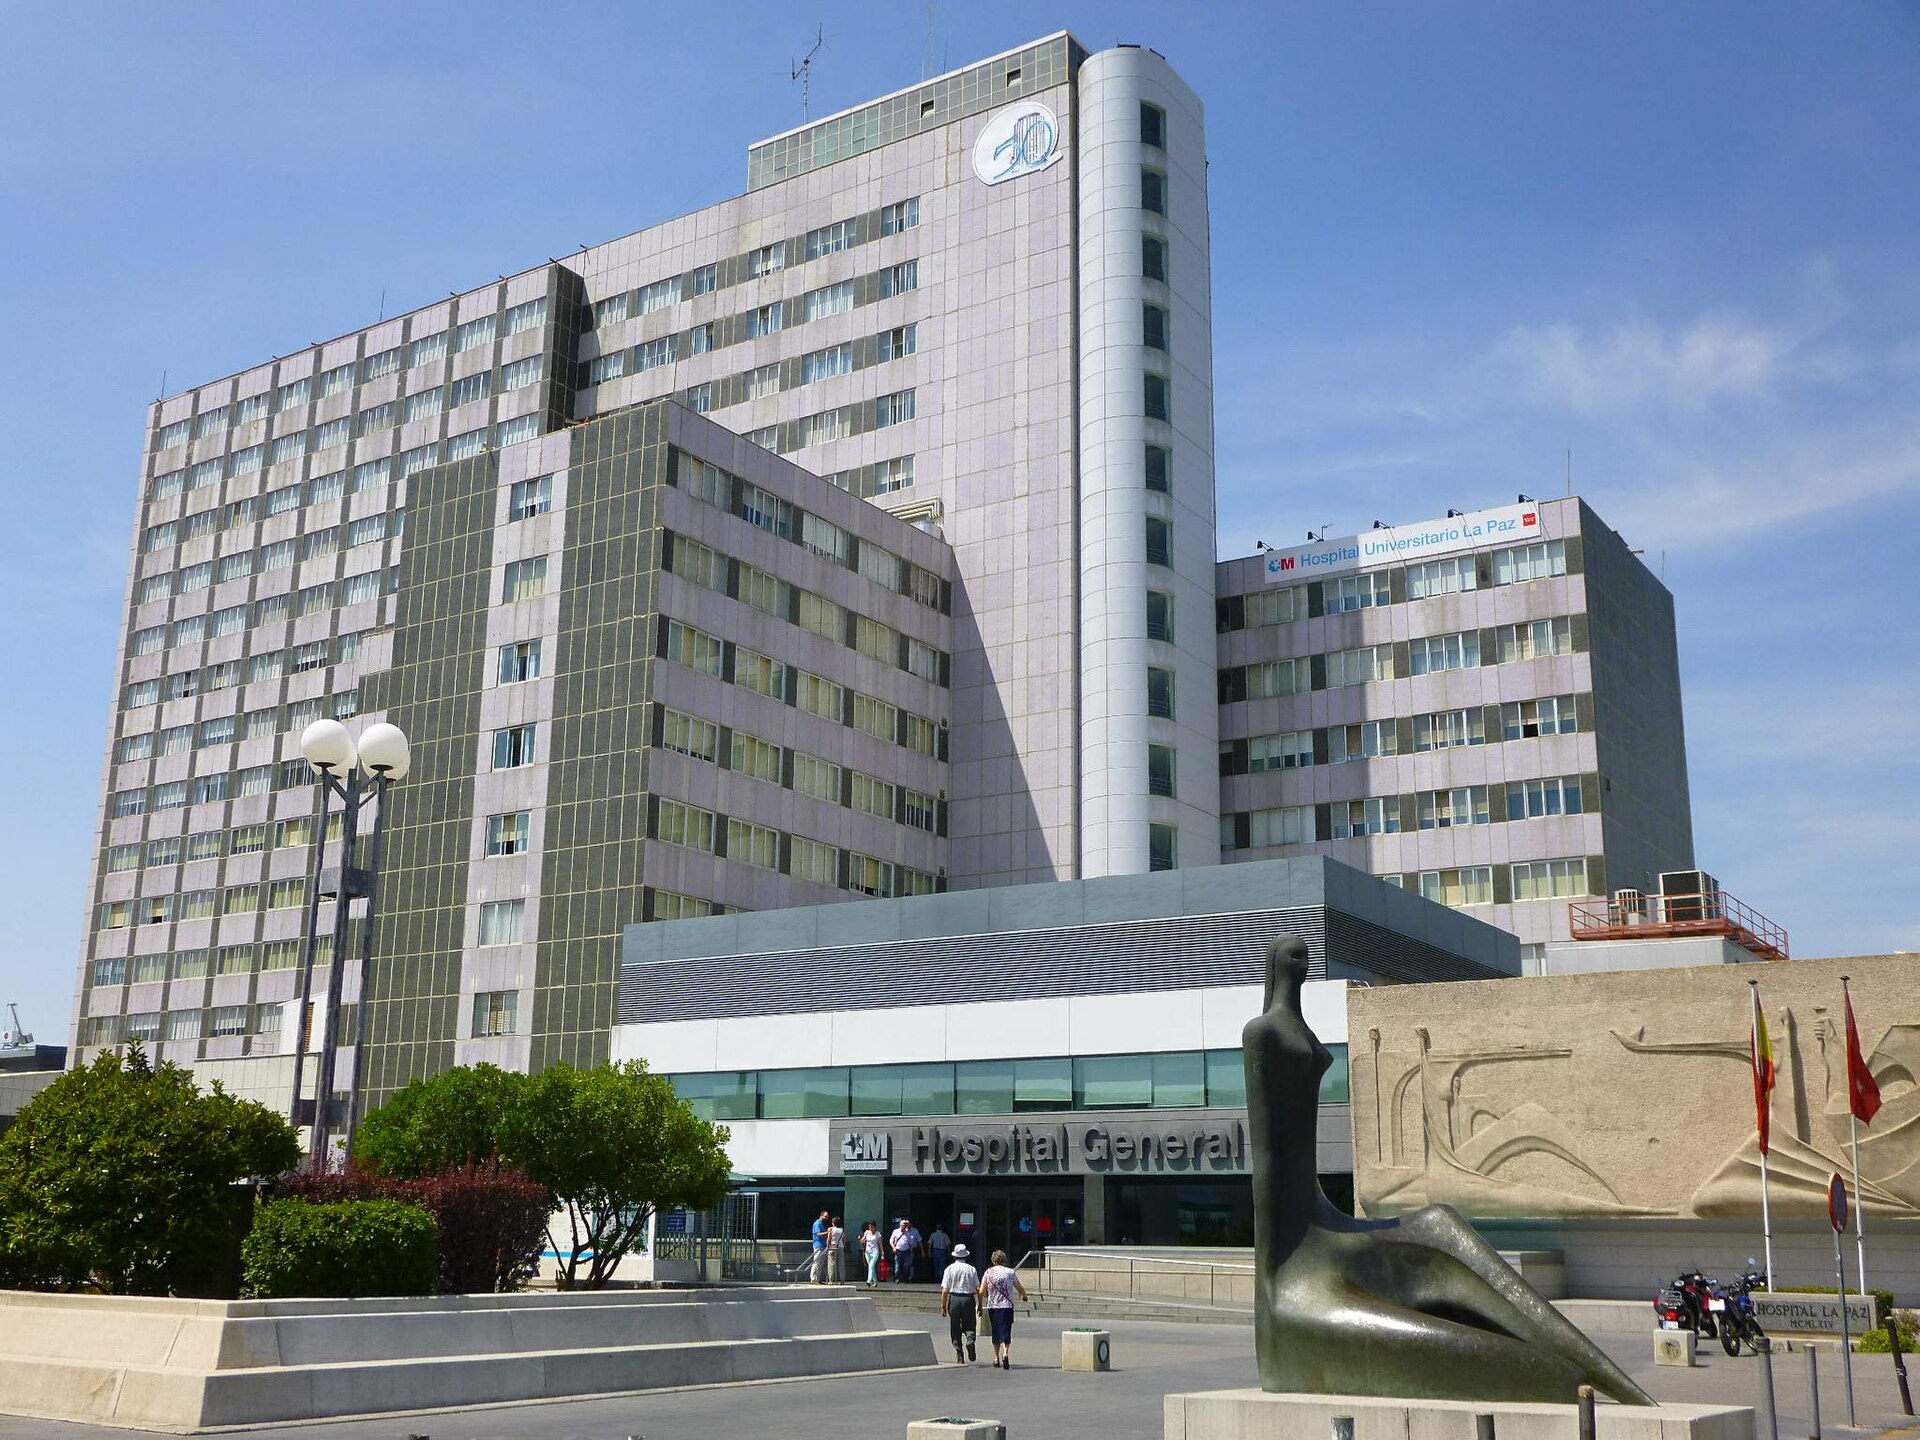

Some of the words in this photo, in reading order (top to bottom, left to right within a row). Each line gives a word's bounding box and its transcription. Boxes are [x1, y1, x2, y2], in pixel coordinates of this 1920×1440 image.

[1301, 544, 1359, 568] Hospital
[1364, 528, 1459, 556] Universitario
[1463, 525, 1482, 538] La
[1487, 519, 1516, 534] Paz
[911, 1123, 1066, 1170] Hospital
[1079, 1120, 1240, 1161] General
[1757, 1303, 1817, 1318] HOSPITAL
[1822, 1305, 1840, 1318] LA
[1844, 1306, 1868, 1319] PAZ
[1790, 1319, 1834, 1329] MCMLXIV
